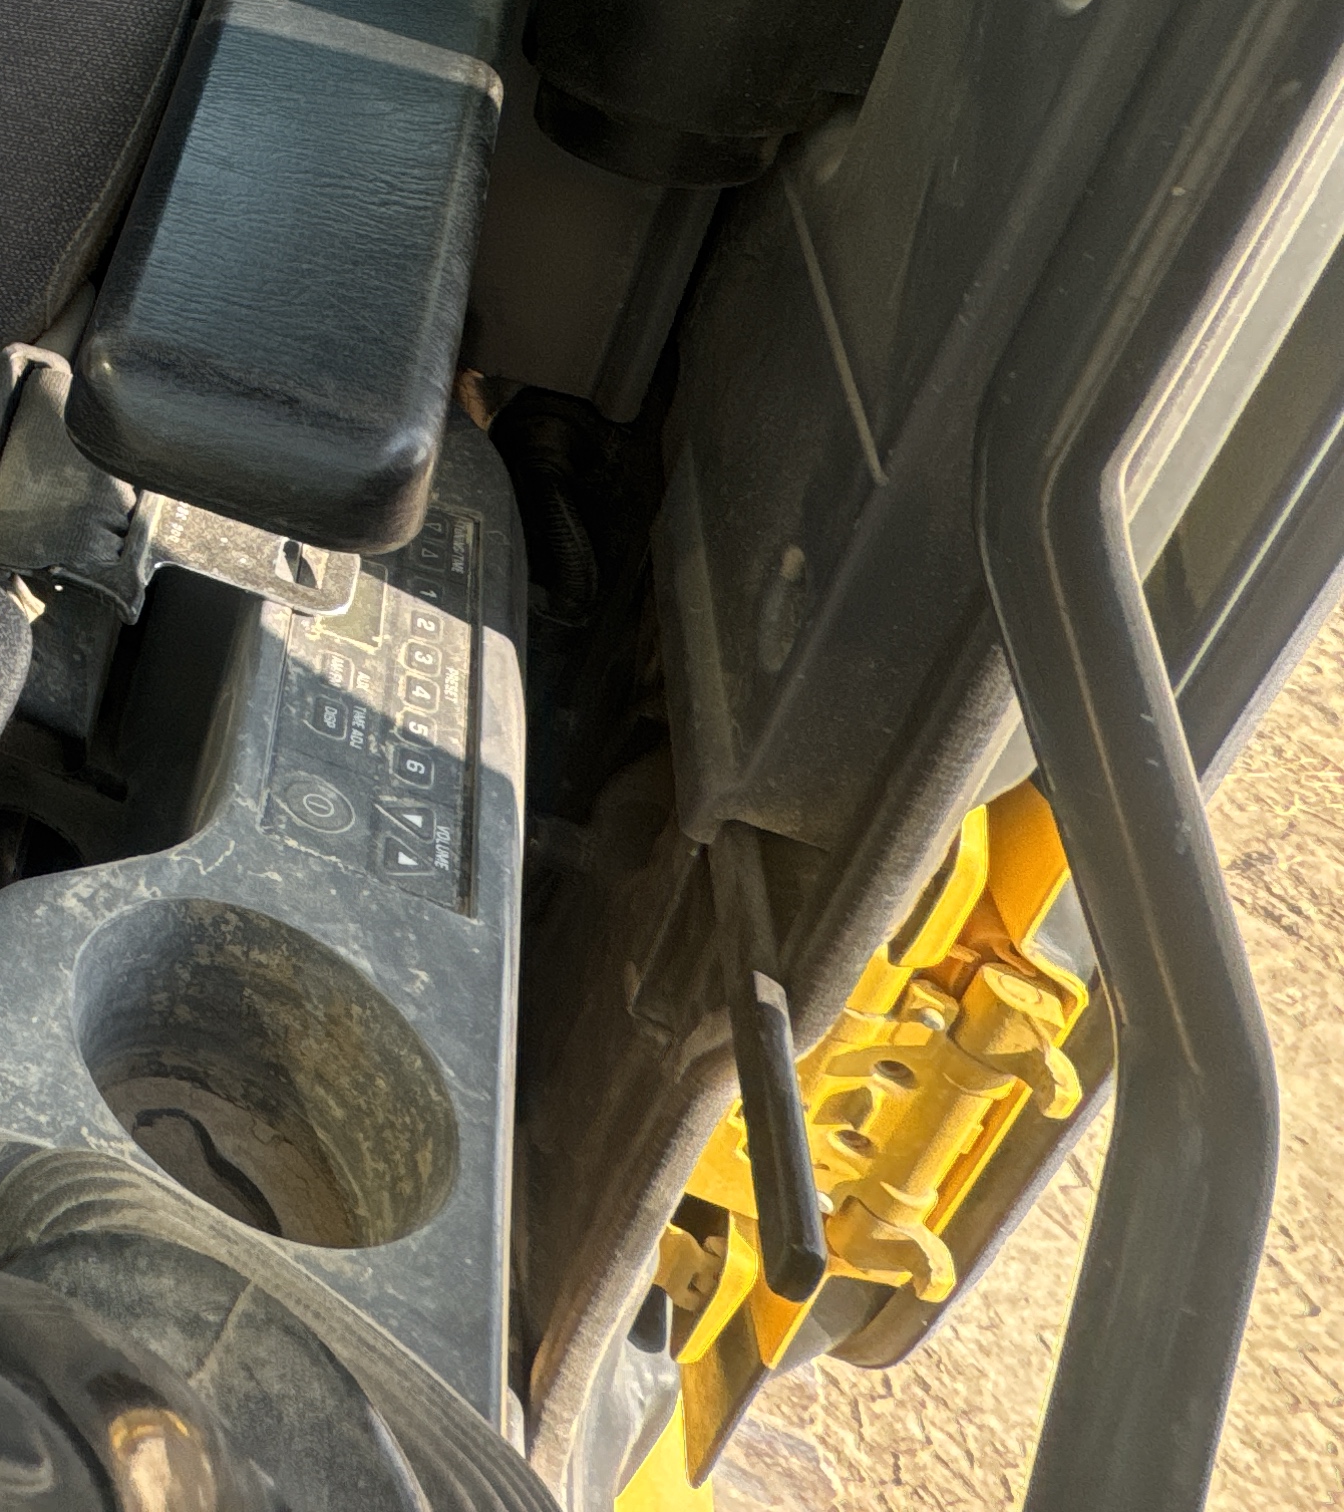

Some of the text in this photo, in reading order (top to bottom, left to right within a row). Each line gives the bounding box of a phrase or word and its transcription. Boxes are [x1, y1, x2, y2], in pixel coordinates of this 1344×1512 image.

[420, 590, 438, 598] 1
[417, 618, 436, 632] 2
[414, 650, 434, 665] 3
[412, 685, 432, 700] 4
[443, 666, 460, 704] PRESET
[324, 706, 338, 729] DISP
[408, 722, 429, 738] 5
[350, 729, 364, 750] ADJ
[406, 760, 426, 775] 6
[434, 826, 450, 871] VOLUME
